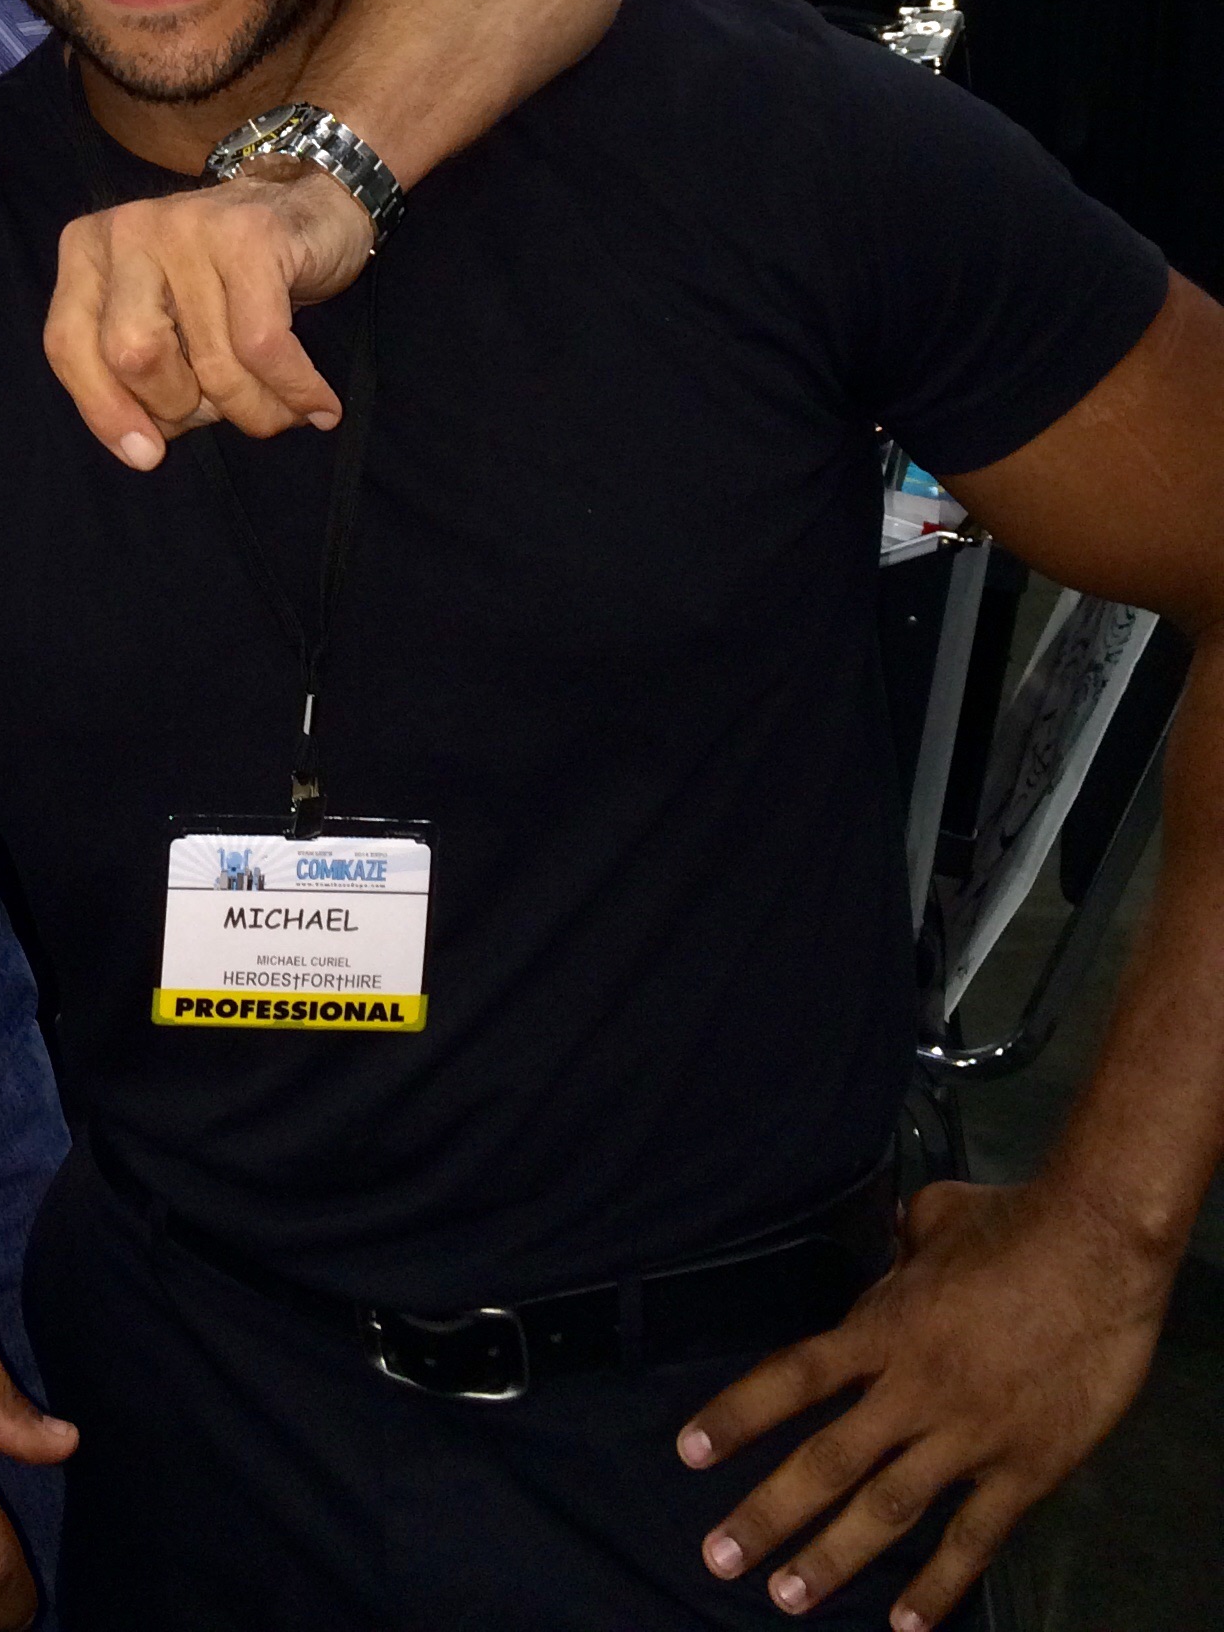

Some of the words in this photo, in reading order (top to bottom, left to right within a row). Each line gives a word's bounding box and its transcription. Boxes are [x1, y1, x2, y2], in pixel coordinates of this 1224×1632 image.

[296, 858, 387, 881] COMIKAZE
[223, 906, 359, 932] MICHAEL
[256, 955, 307, 967] MICHAEL
[310, 956, 352, 968] CURIEL
[175, 997, 405, 1023] PROFESSIONAL
